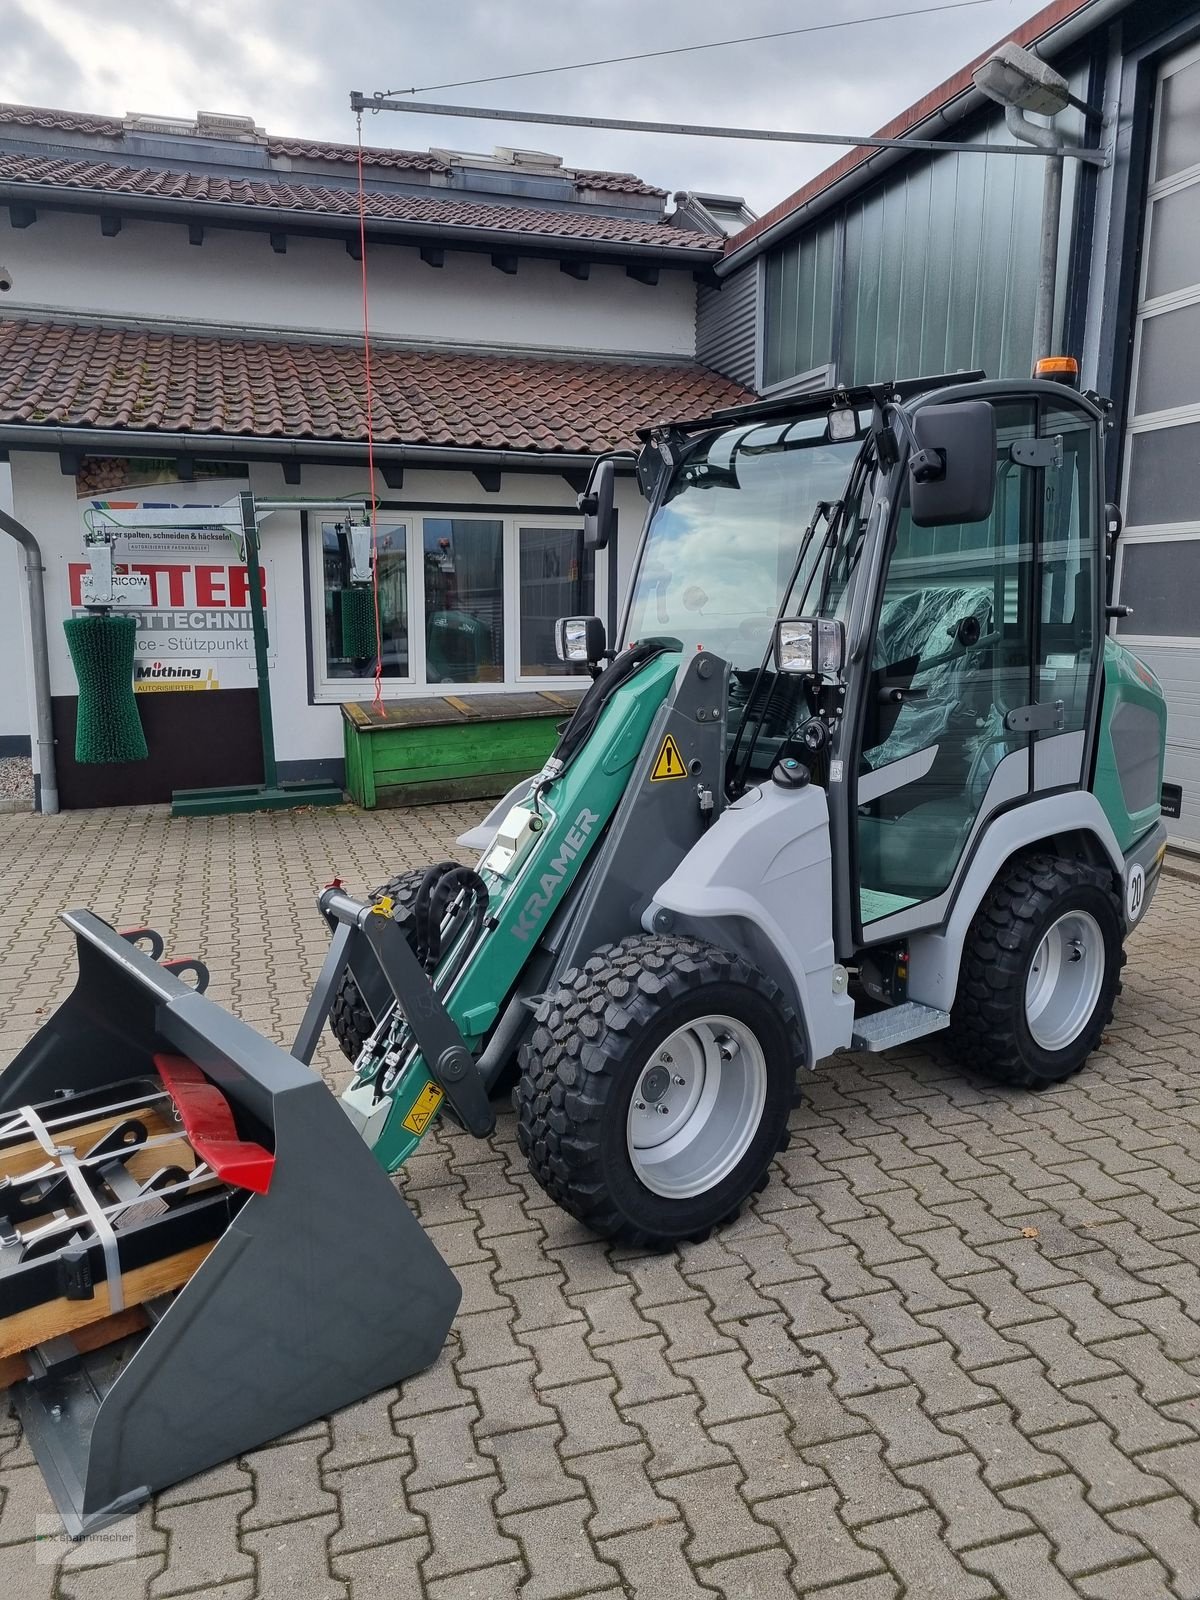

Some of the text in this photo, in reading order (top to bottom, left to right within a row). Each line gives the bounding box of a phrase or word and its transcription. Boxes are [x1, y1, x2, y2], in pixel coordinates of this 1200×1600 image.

[124, 531, 152, 541] spalten,
[153, 531, 189, 541] schneiden
[198, 532, 232, 542] häckseln!
[68, 563, 267, 608] TTER
[111, 577, 148, 586] RICOW
[167, 637, 249, 654] Stützpunkt
[136, 662, 203, 679] Müthing
[136, 684, 195, 692] AUTORISIERTER
[511, 808, 600, 941] KRAMER
[1131, 873, 1141, 912] 20
